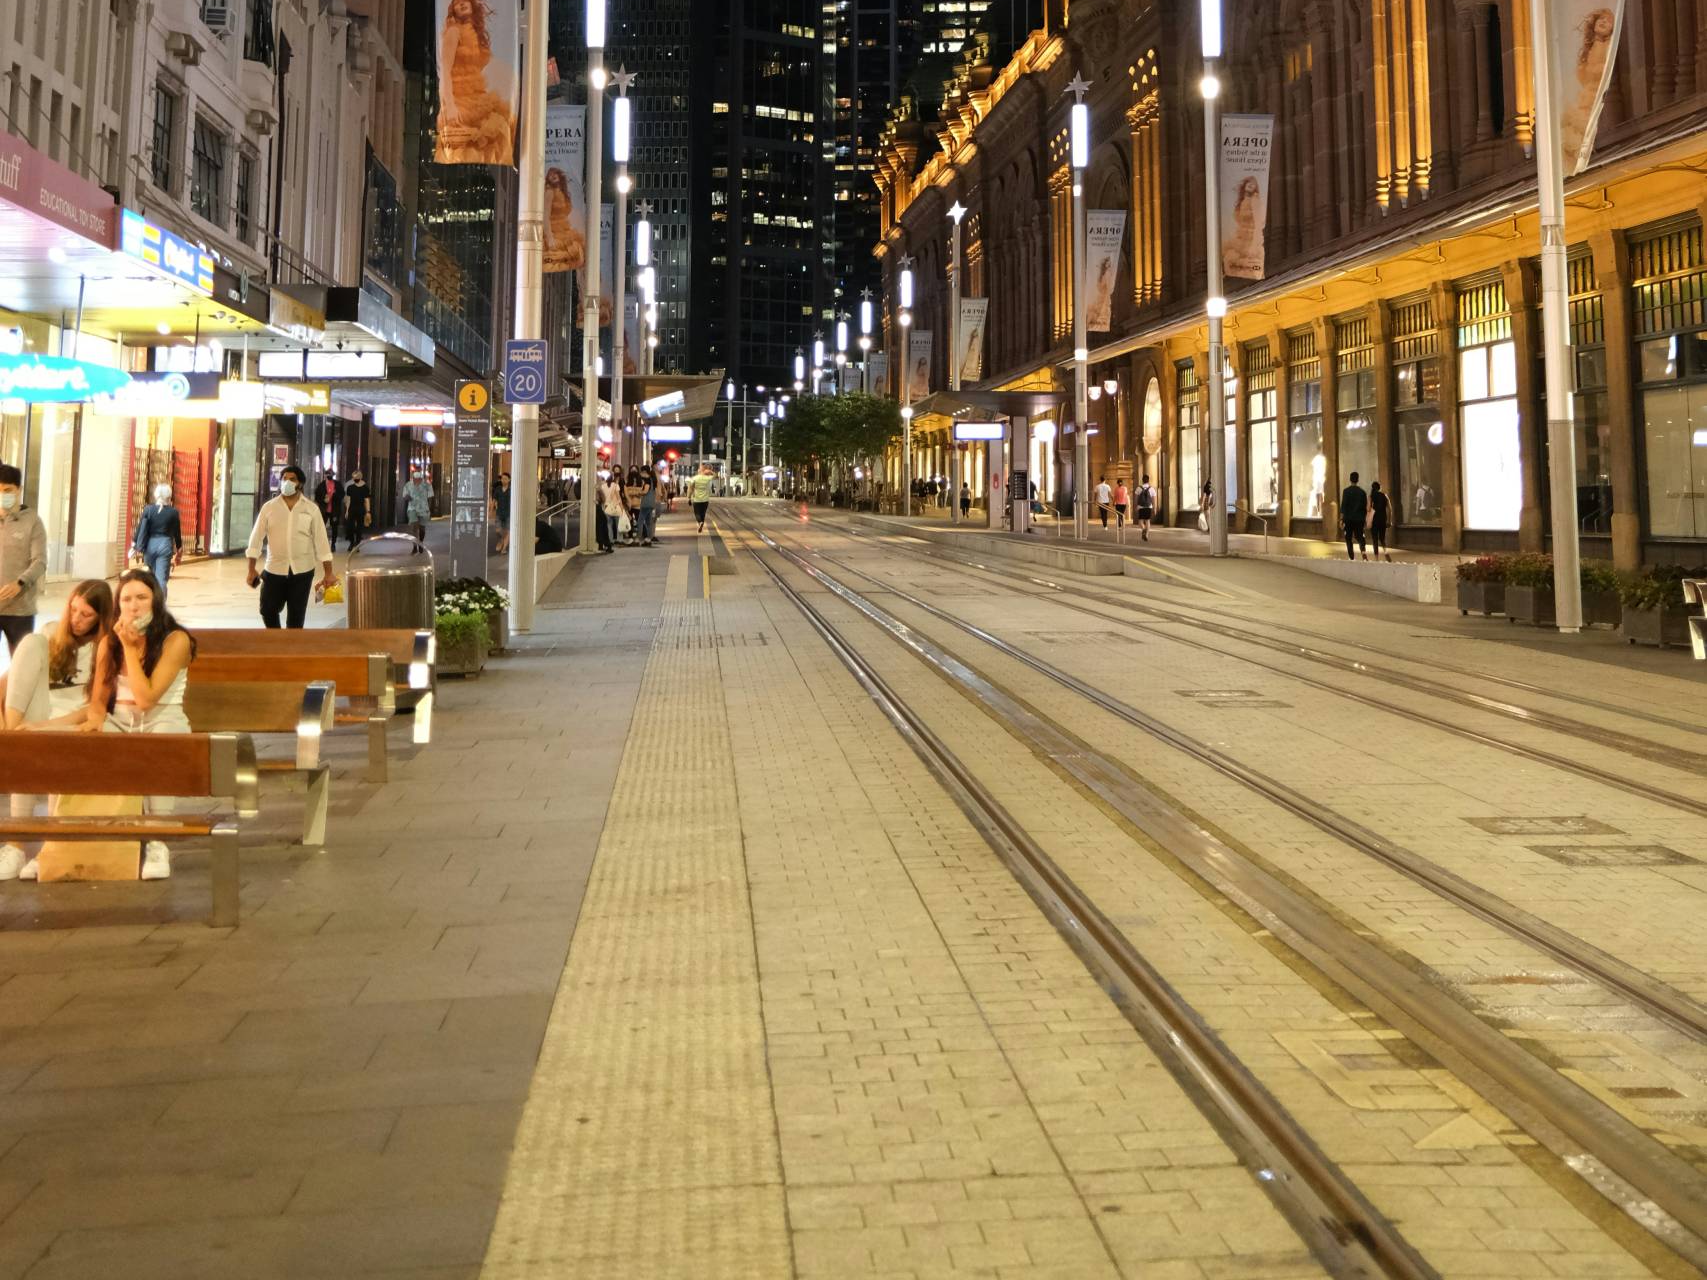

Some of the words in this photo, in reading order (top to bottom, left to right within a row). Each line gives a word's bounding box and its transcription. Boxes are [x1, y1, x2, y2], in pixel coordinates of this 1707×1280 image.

[545, 128, 582, 138] PERA
[40, 187, 78, 223] EDUCATIONAL
[79, 208, 90, 228] TOY
[89, 213, 106, 236] STORE
[515, 374, 536, 391] 20
